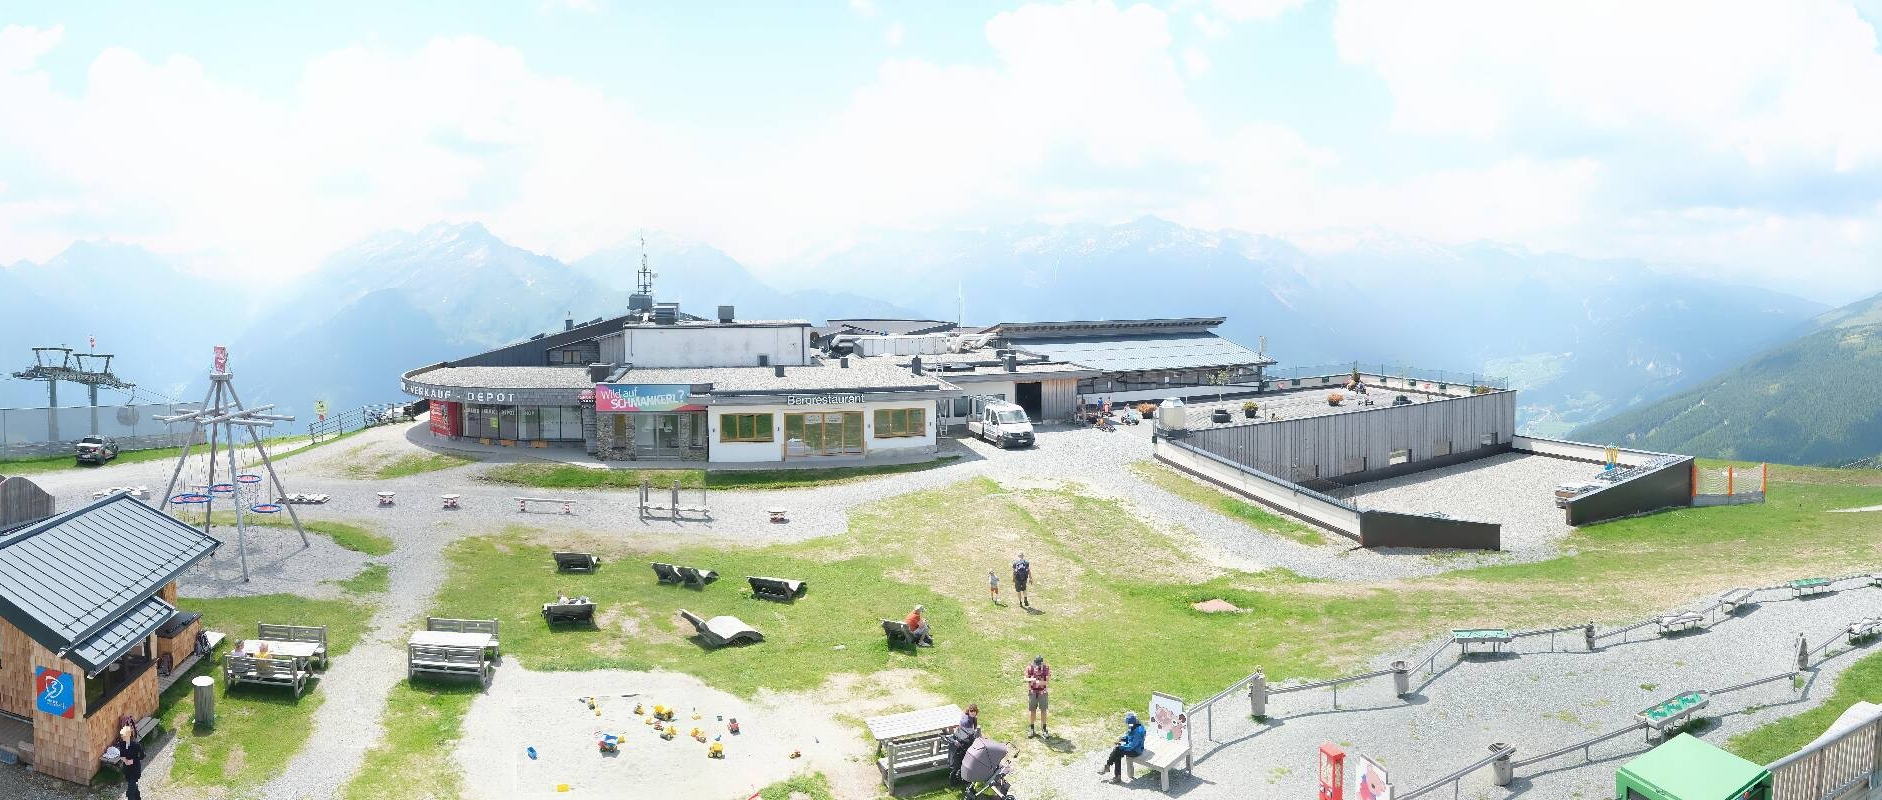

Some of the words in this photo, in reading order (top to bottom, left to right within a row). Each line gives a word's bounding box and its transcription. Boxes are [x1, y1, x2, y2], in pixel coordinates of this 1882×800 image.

[410, 385, 451, 399] VERKAUF
[467, 392, 515, 402] DEPOT
[601, 388, 621, 400] Wild
[622, 386, 638, 397] auf
[610, 389, 685, 409] SCHMANKERL?
[787, 393, 866, 406] Bergrestaurant
